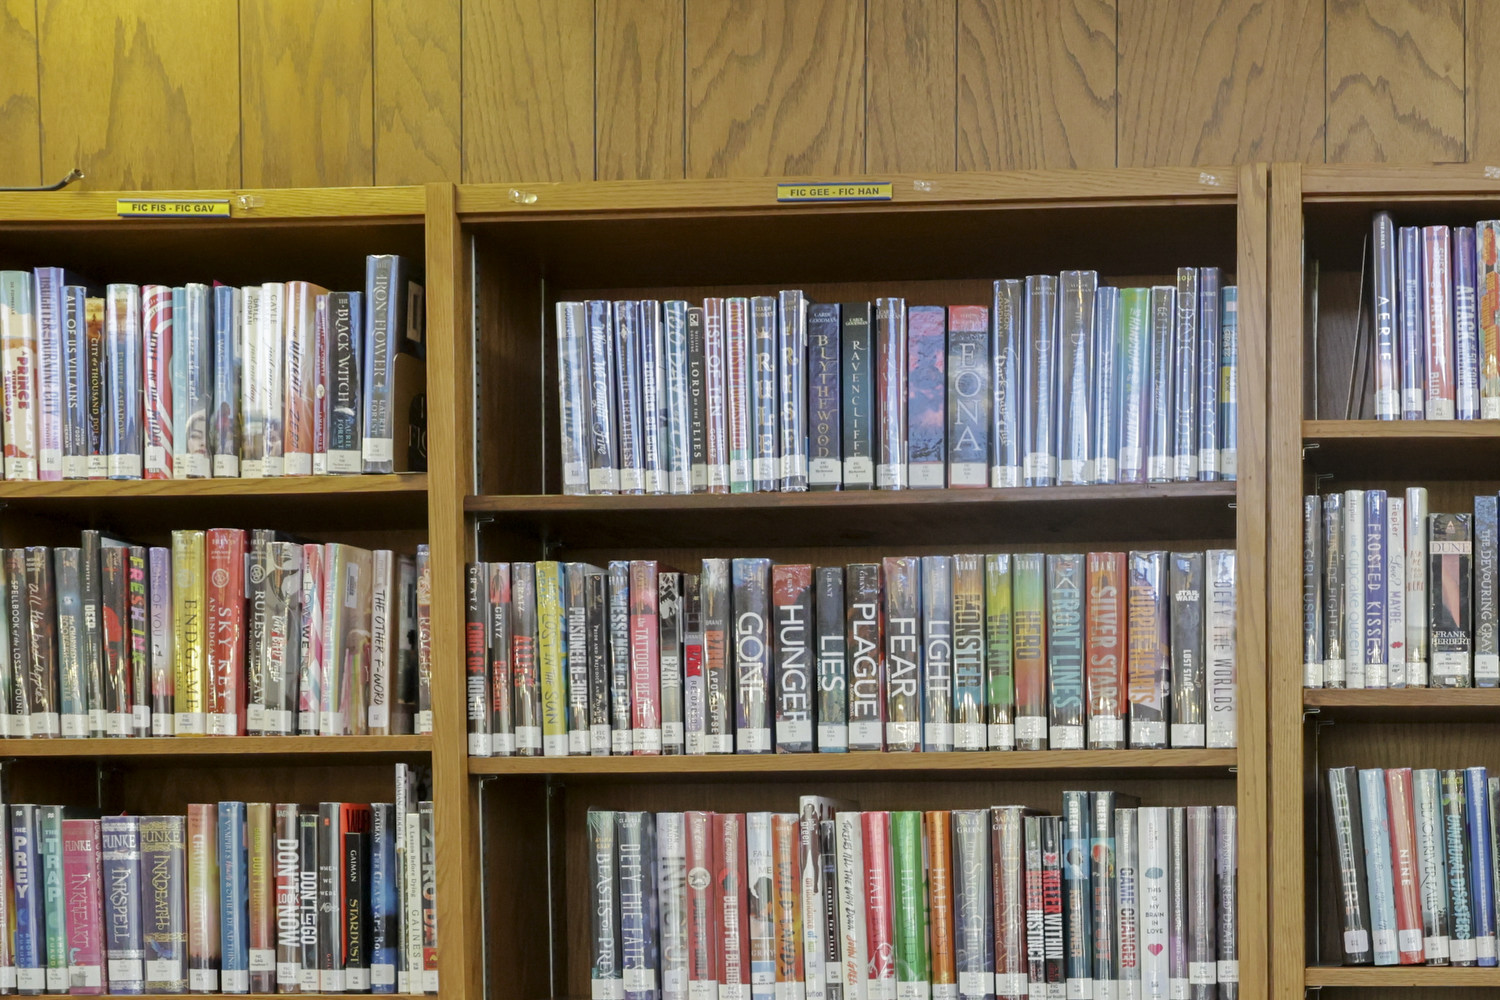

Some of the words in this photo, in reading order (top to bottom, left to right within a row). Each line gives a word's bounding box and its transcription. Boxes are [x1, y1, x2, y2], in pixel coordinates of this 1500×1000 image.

[132, 204, 149, 212] FIC
[151, 204, 166, 212] FIS
[174, 204, 190, 212] FIC
[194, 204, 214, 212] GAV
[790, 189, 806, 197] FIC
[809, 189, 828, 197] GEE
[838, 189, 854, 197] FIC
[859, 187, 879, 196] HAN
[66, 296, 75, 313] ALL
[68, 319, 76, 335] OF
[336, 308, 349, 351] BLACK
[1377, 296, 1391, 361] AERIE
[68, 340, 77, 352] US
[68, 356, 77, 409] VILLAINS
[338, 354, 350, 402] WITCH
[955, 343, 981, 451] EONA
[693, 421, 701, 458] FLIES
[1367, 523, 1381, 592] FROSTED
[218, 608, 232, 648] SKY
[1052, 588, 1080, 648] FRONT
[1367, 602, 1381, 656] KISSES
[185, 600, 198, 711] ENDGAME
[218, 659, 231, 701] KEY
[779, 605, 806, 721] HUNGER
[820, 636, 844, 692] LIES
[889, 617, 916, 697] FEAR
[929, 621, 950, 697] LIGHT
[1052, 655, 1080, 708] LINES
[15, 836, 29, 898] PREY
[46, 839, 60, 902] TRAP
[1400, 849, 1411, 886] NINE
[349, 899, 359, 962] STARDUST
